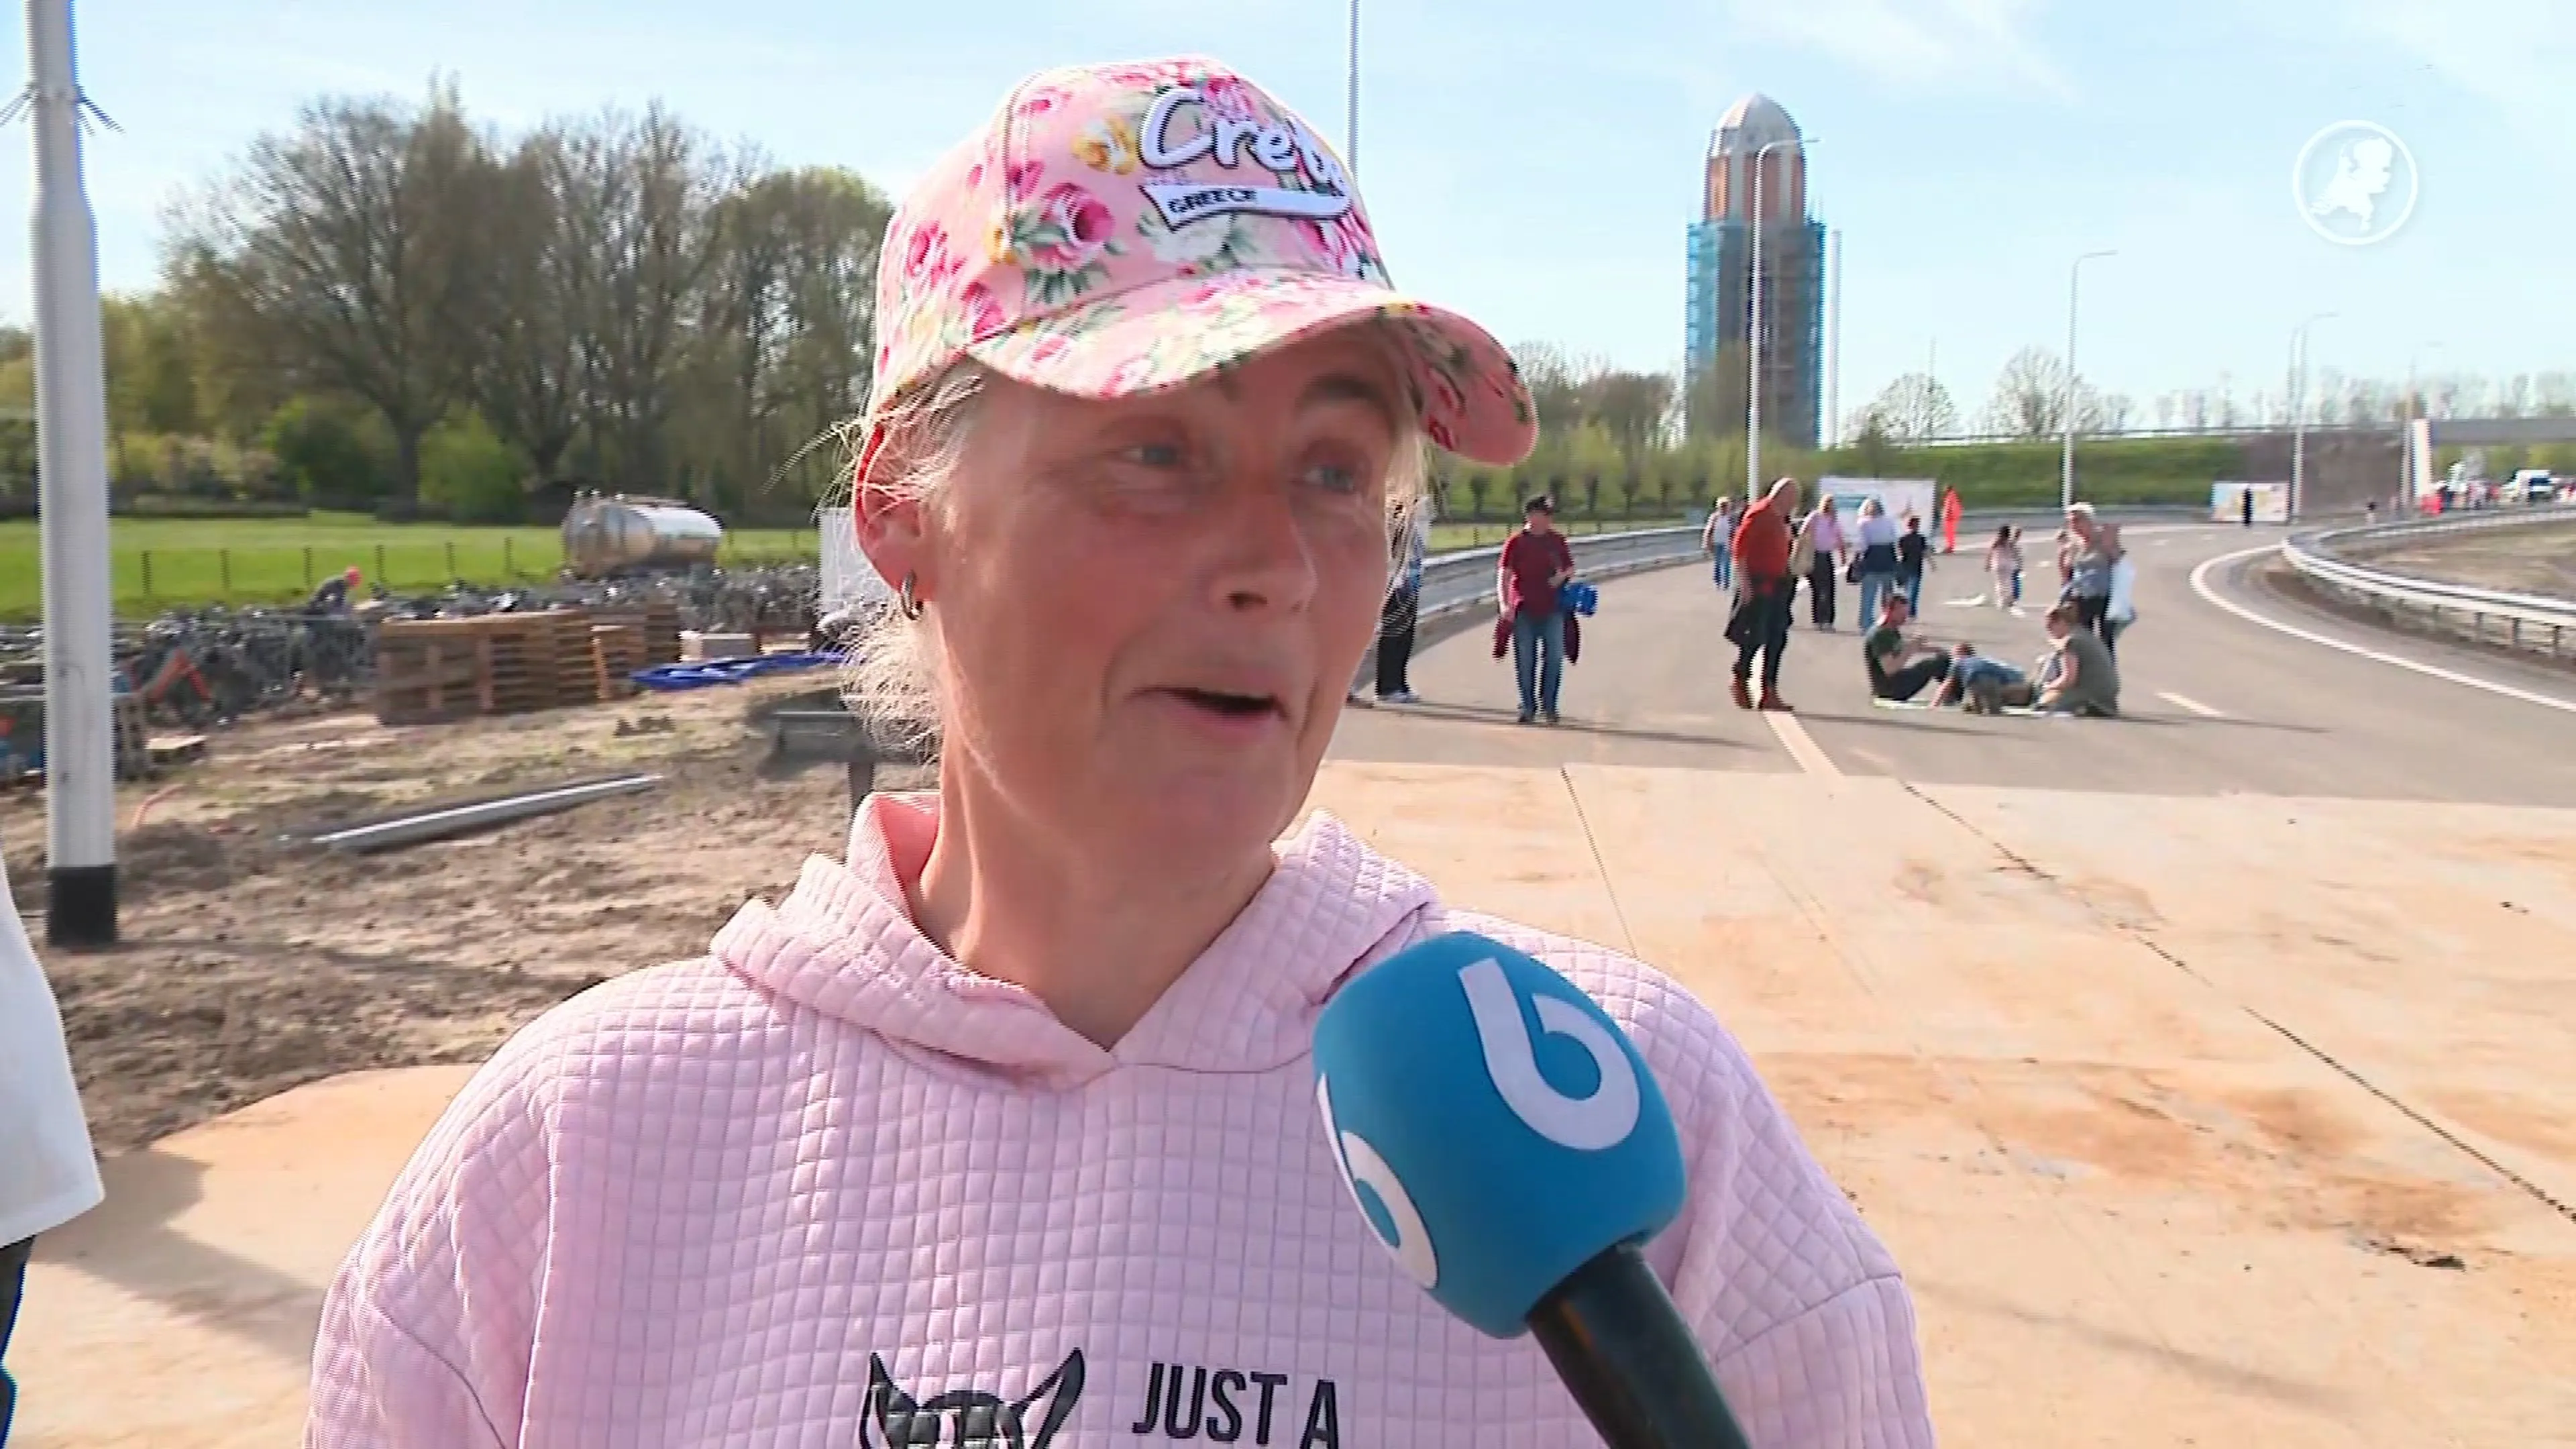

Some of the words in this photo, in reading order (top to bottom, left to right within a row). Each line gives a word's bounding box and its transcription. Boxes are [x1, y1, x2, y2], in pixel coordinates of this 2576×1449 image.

[1167, 188, 1257, 213] GREECE
[1132, 1362, 1288, 1446] JUST
[1299, 1379, 1339, 1449] A
